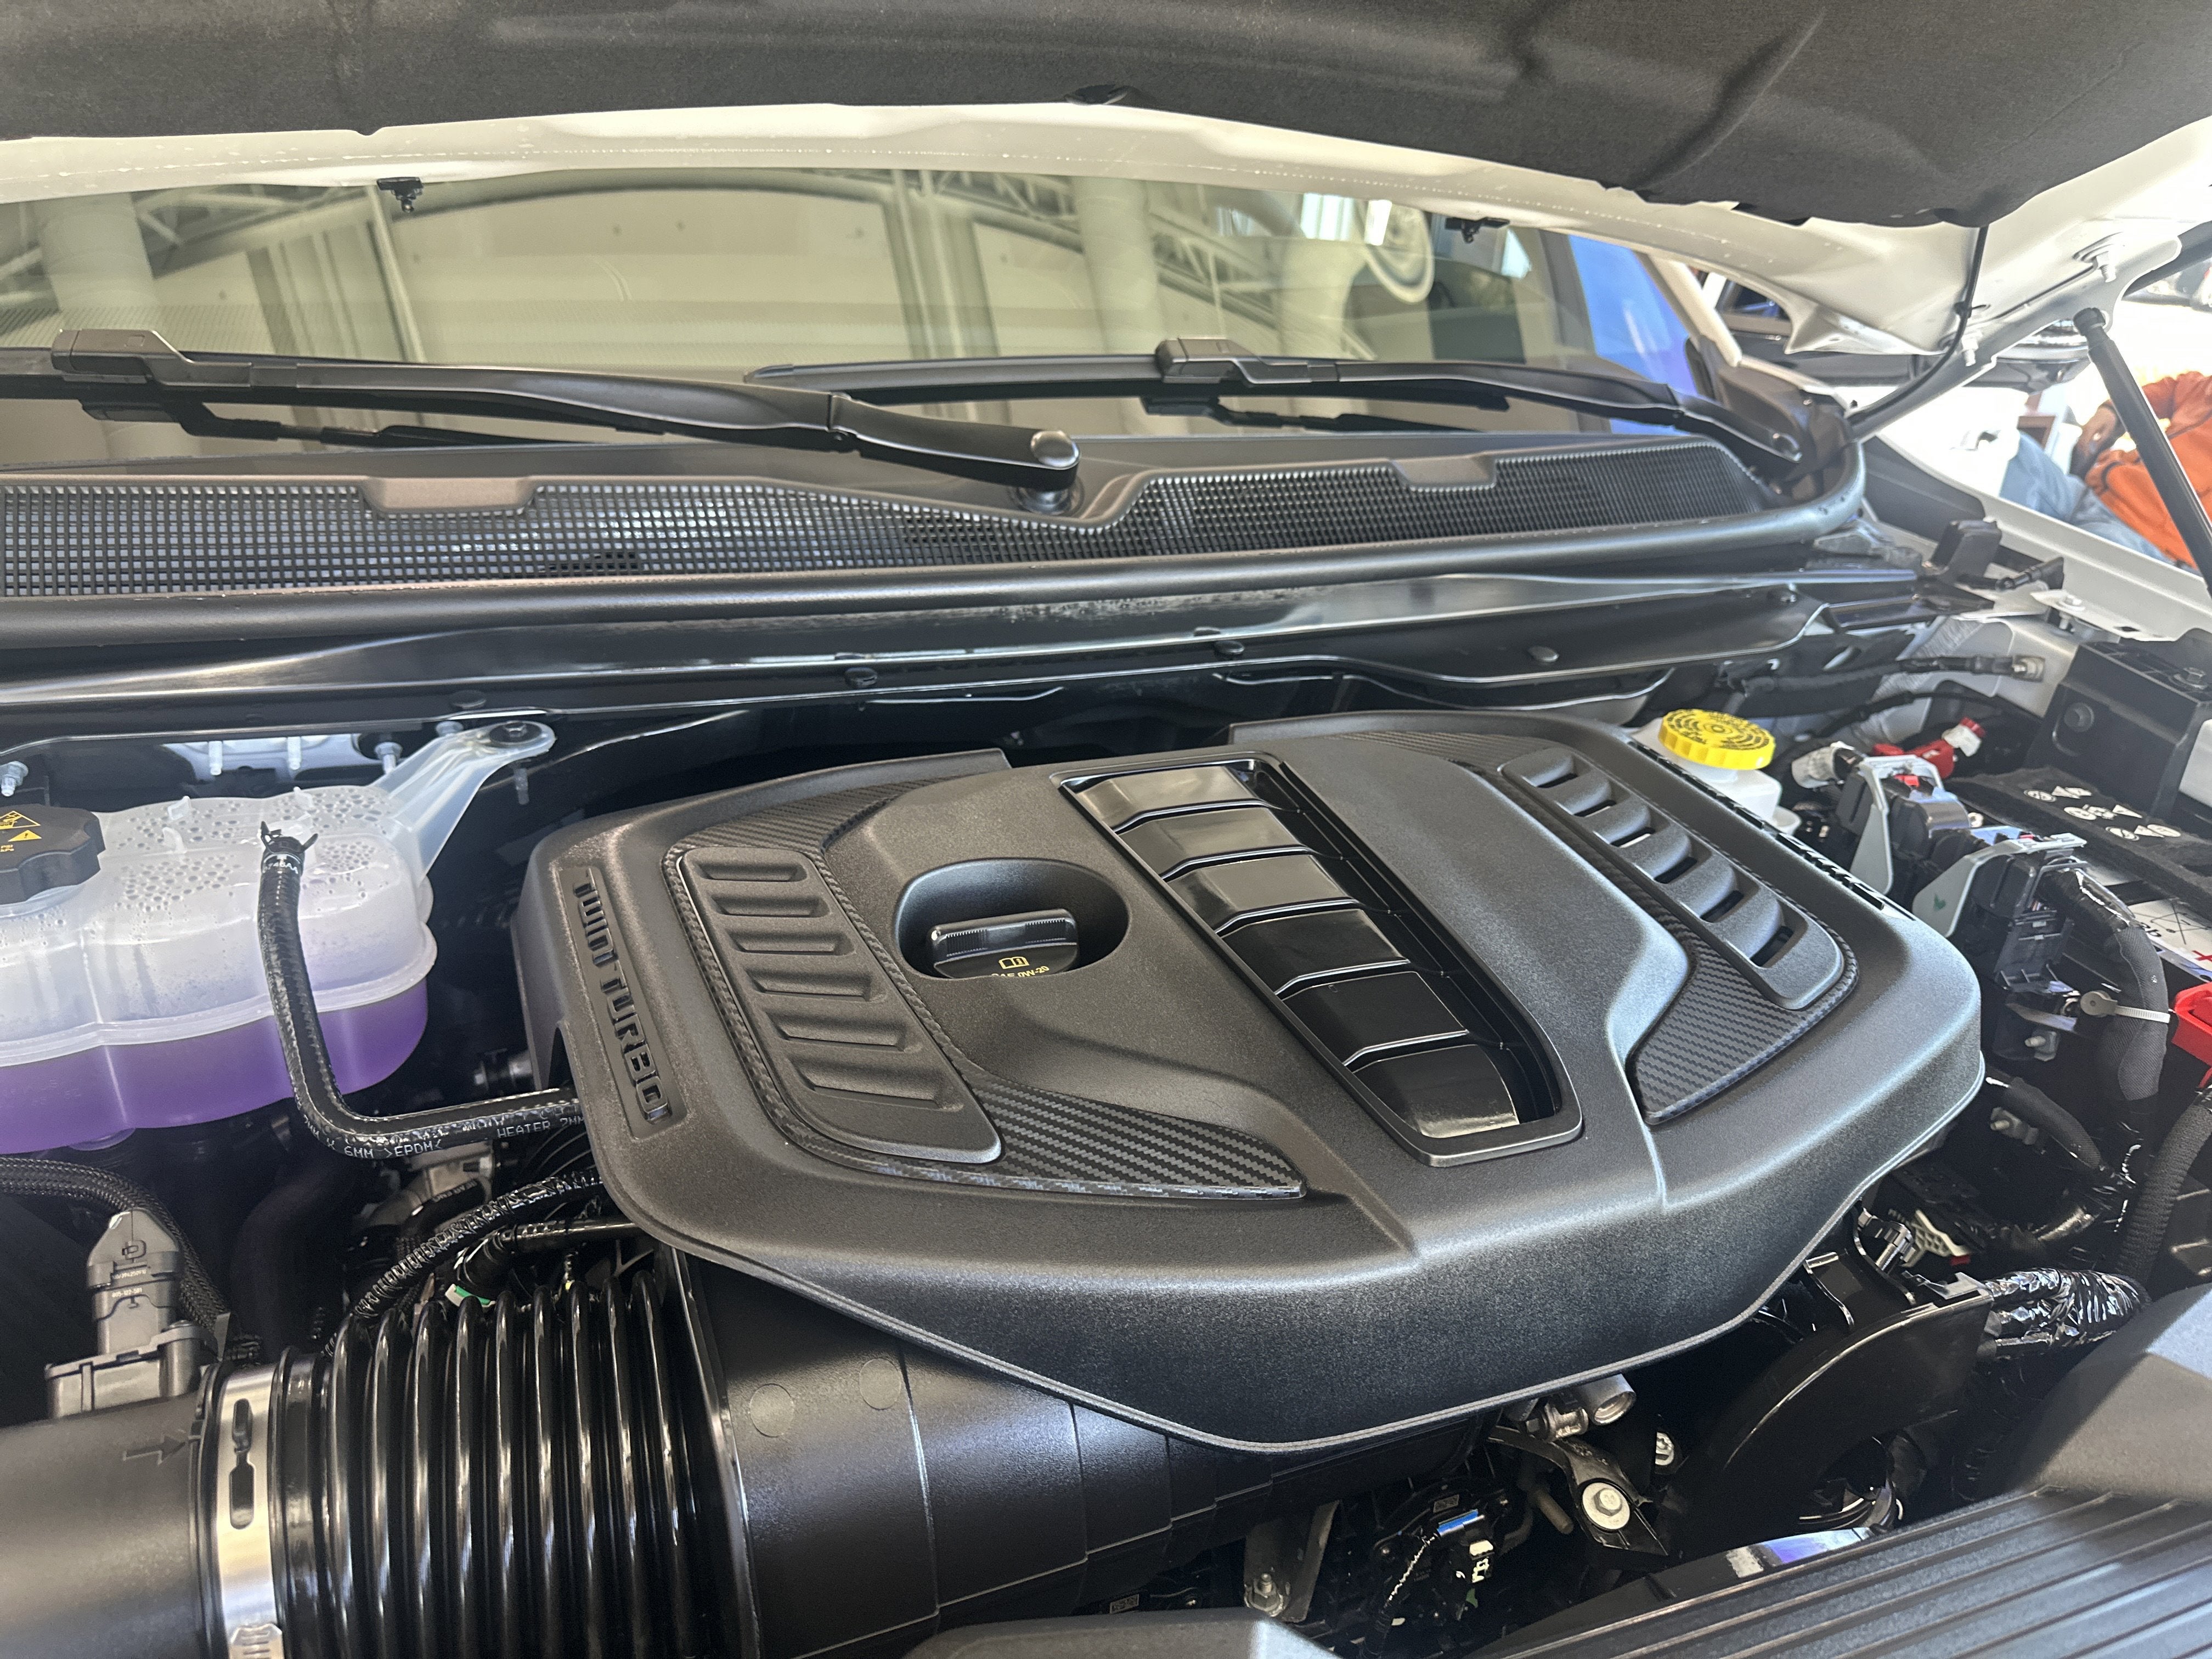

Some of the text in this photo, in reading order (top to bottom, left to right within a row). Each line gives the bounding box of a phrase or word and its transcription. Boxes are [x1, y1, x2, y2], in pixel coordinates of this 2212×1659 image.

[1017, 966, 1050, 977] 0W-20
[572, 868, 672, 1124] TWIN TURBO
[344, 1146, 374, 1158] 6MM
[496, 1120, 551, 1138] HEATER
